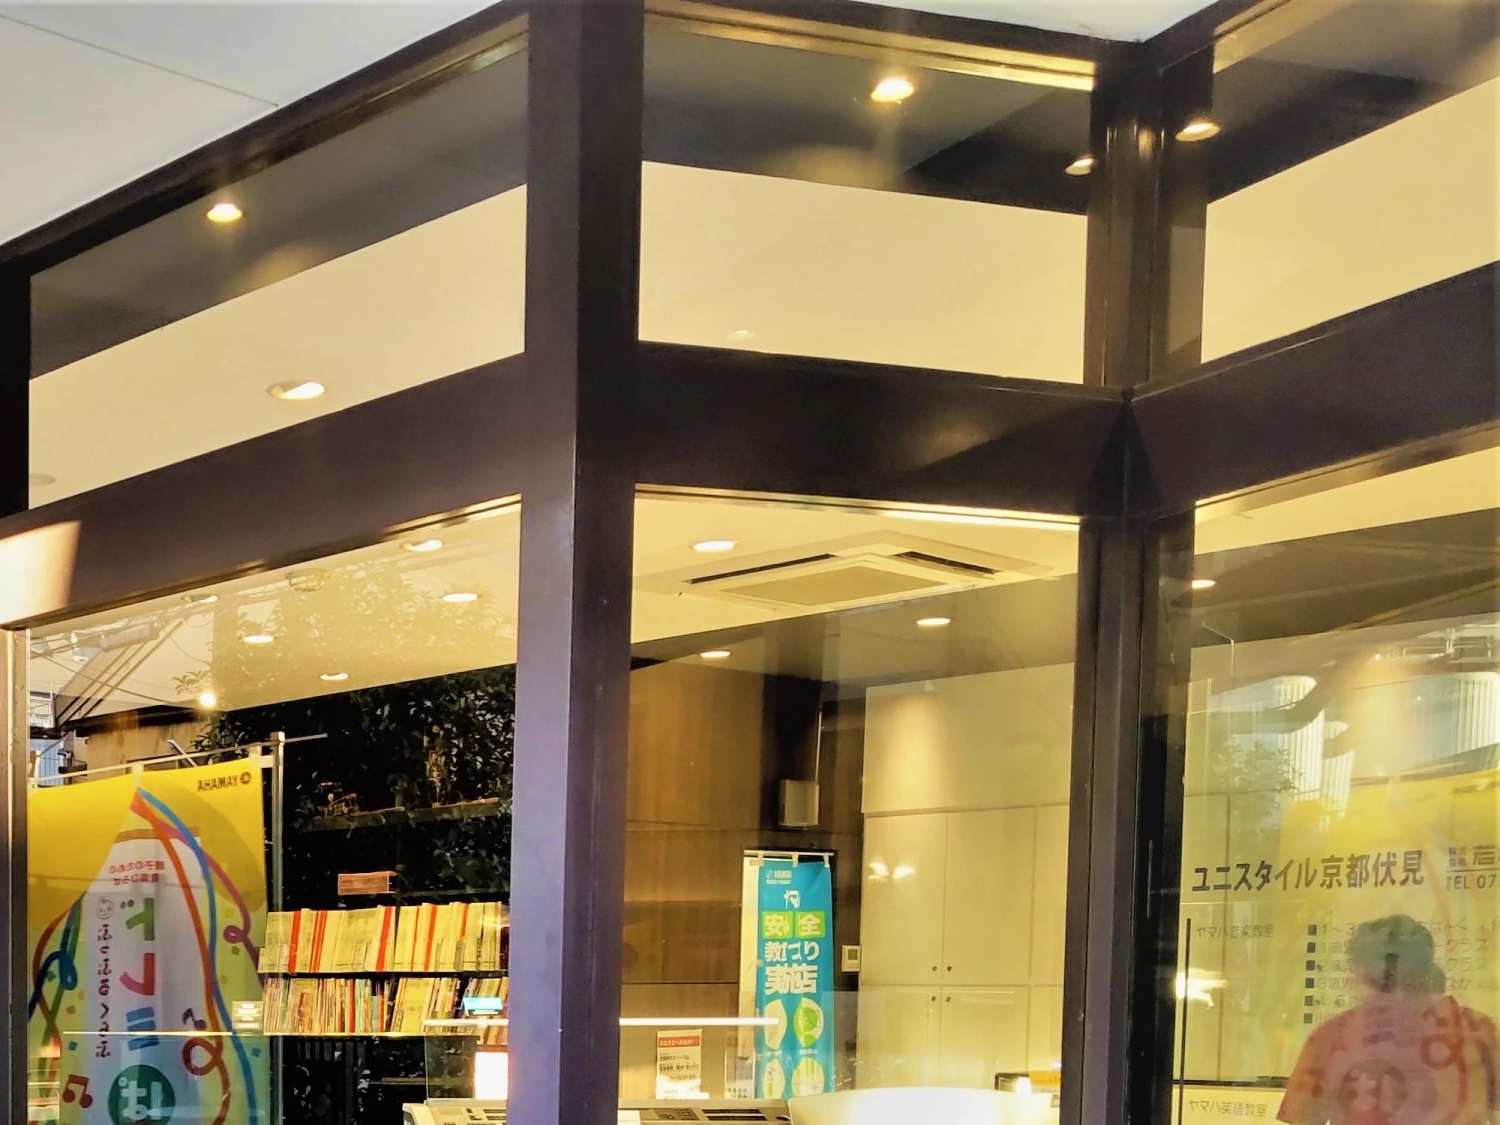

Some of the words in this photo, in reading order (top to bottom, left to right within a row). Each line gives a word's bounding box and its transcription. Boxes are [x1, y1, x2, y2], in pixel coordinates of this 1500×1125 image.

[1192, 850, 1424, 892] ユニスタイル京都伏見
[1188, 1100, 1268, 1117] ヤマハ英語教室
